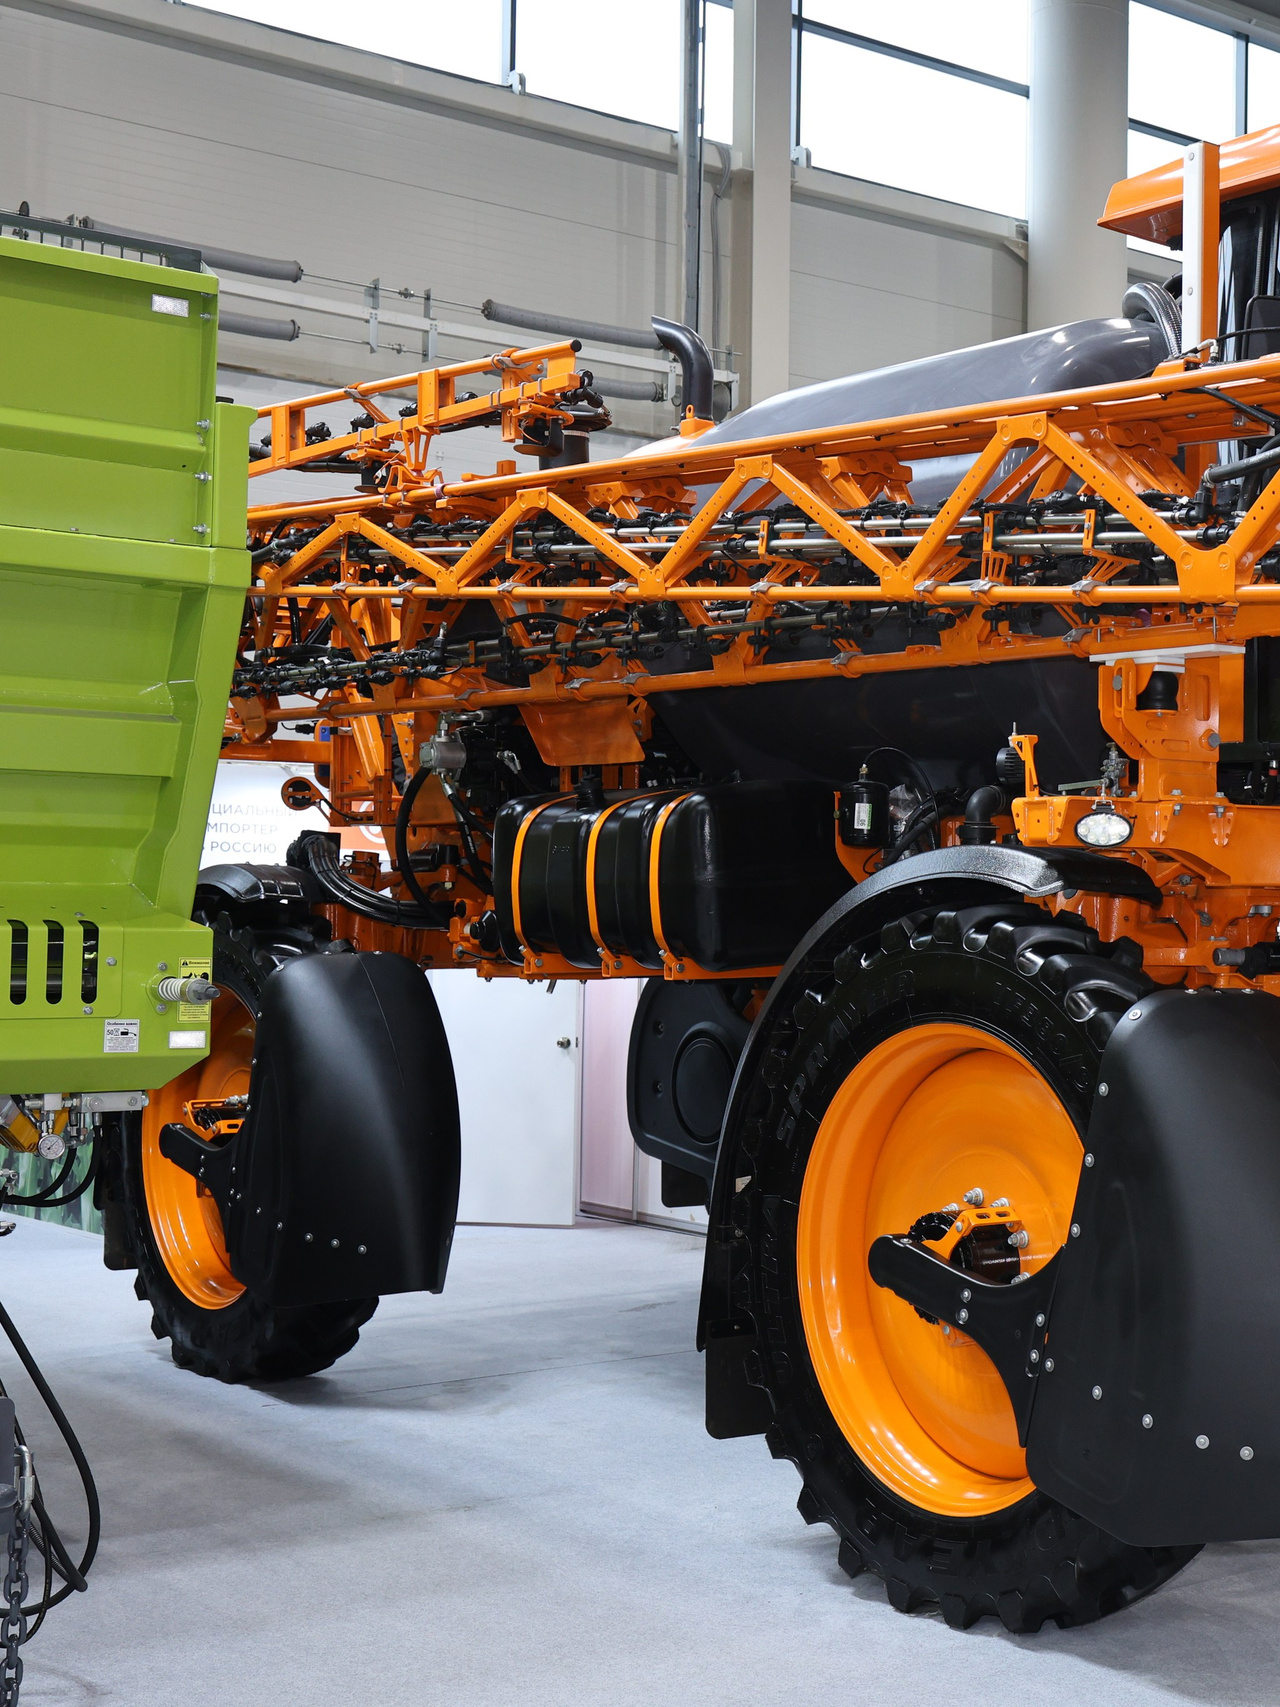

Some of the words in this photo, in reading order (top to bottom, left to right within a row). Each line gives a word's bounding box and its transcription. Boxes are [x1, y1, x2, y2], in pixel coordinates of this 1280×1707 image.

[212, 803, 298, 816] ЦИАЛЬНЫЙ
[206, 822, 278, 835] МПОРТЕР
[210, 841, 277, 853] РОССИЮ
